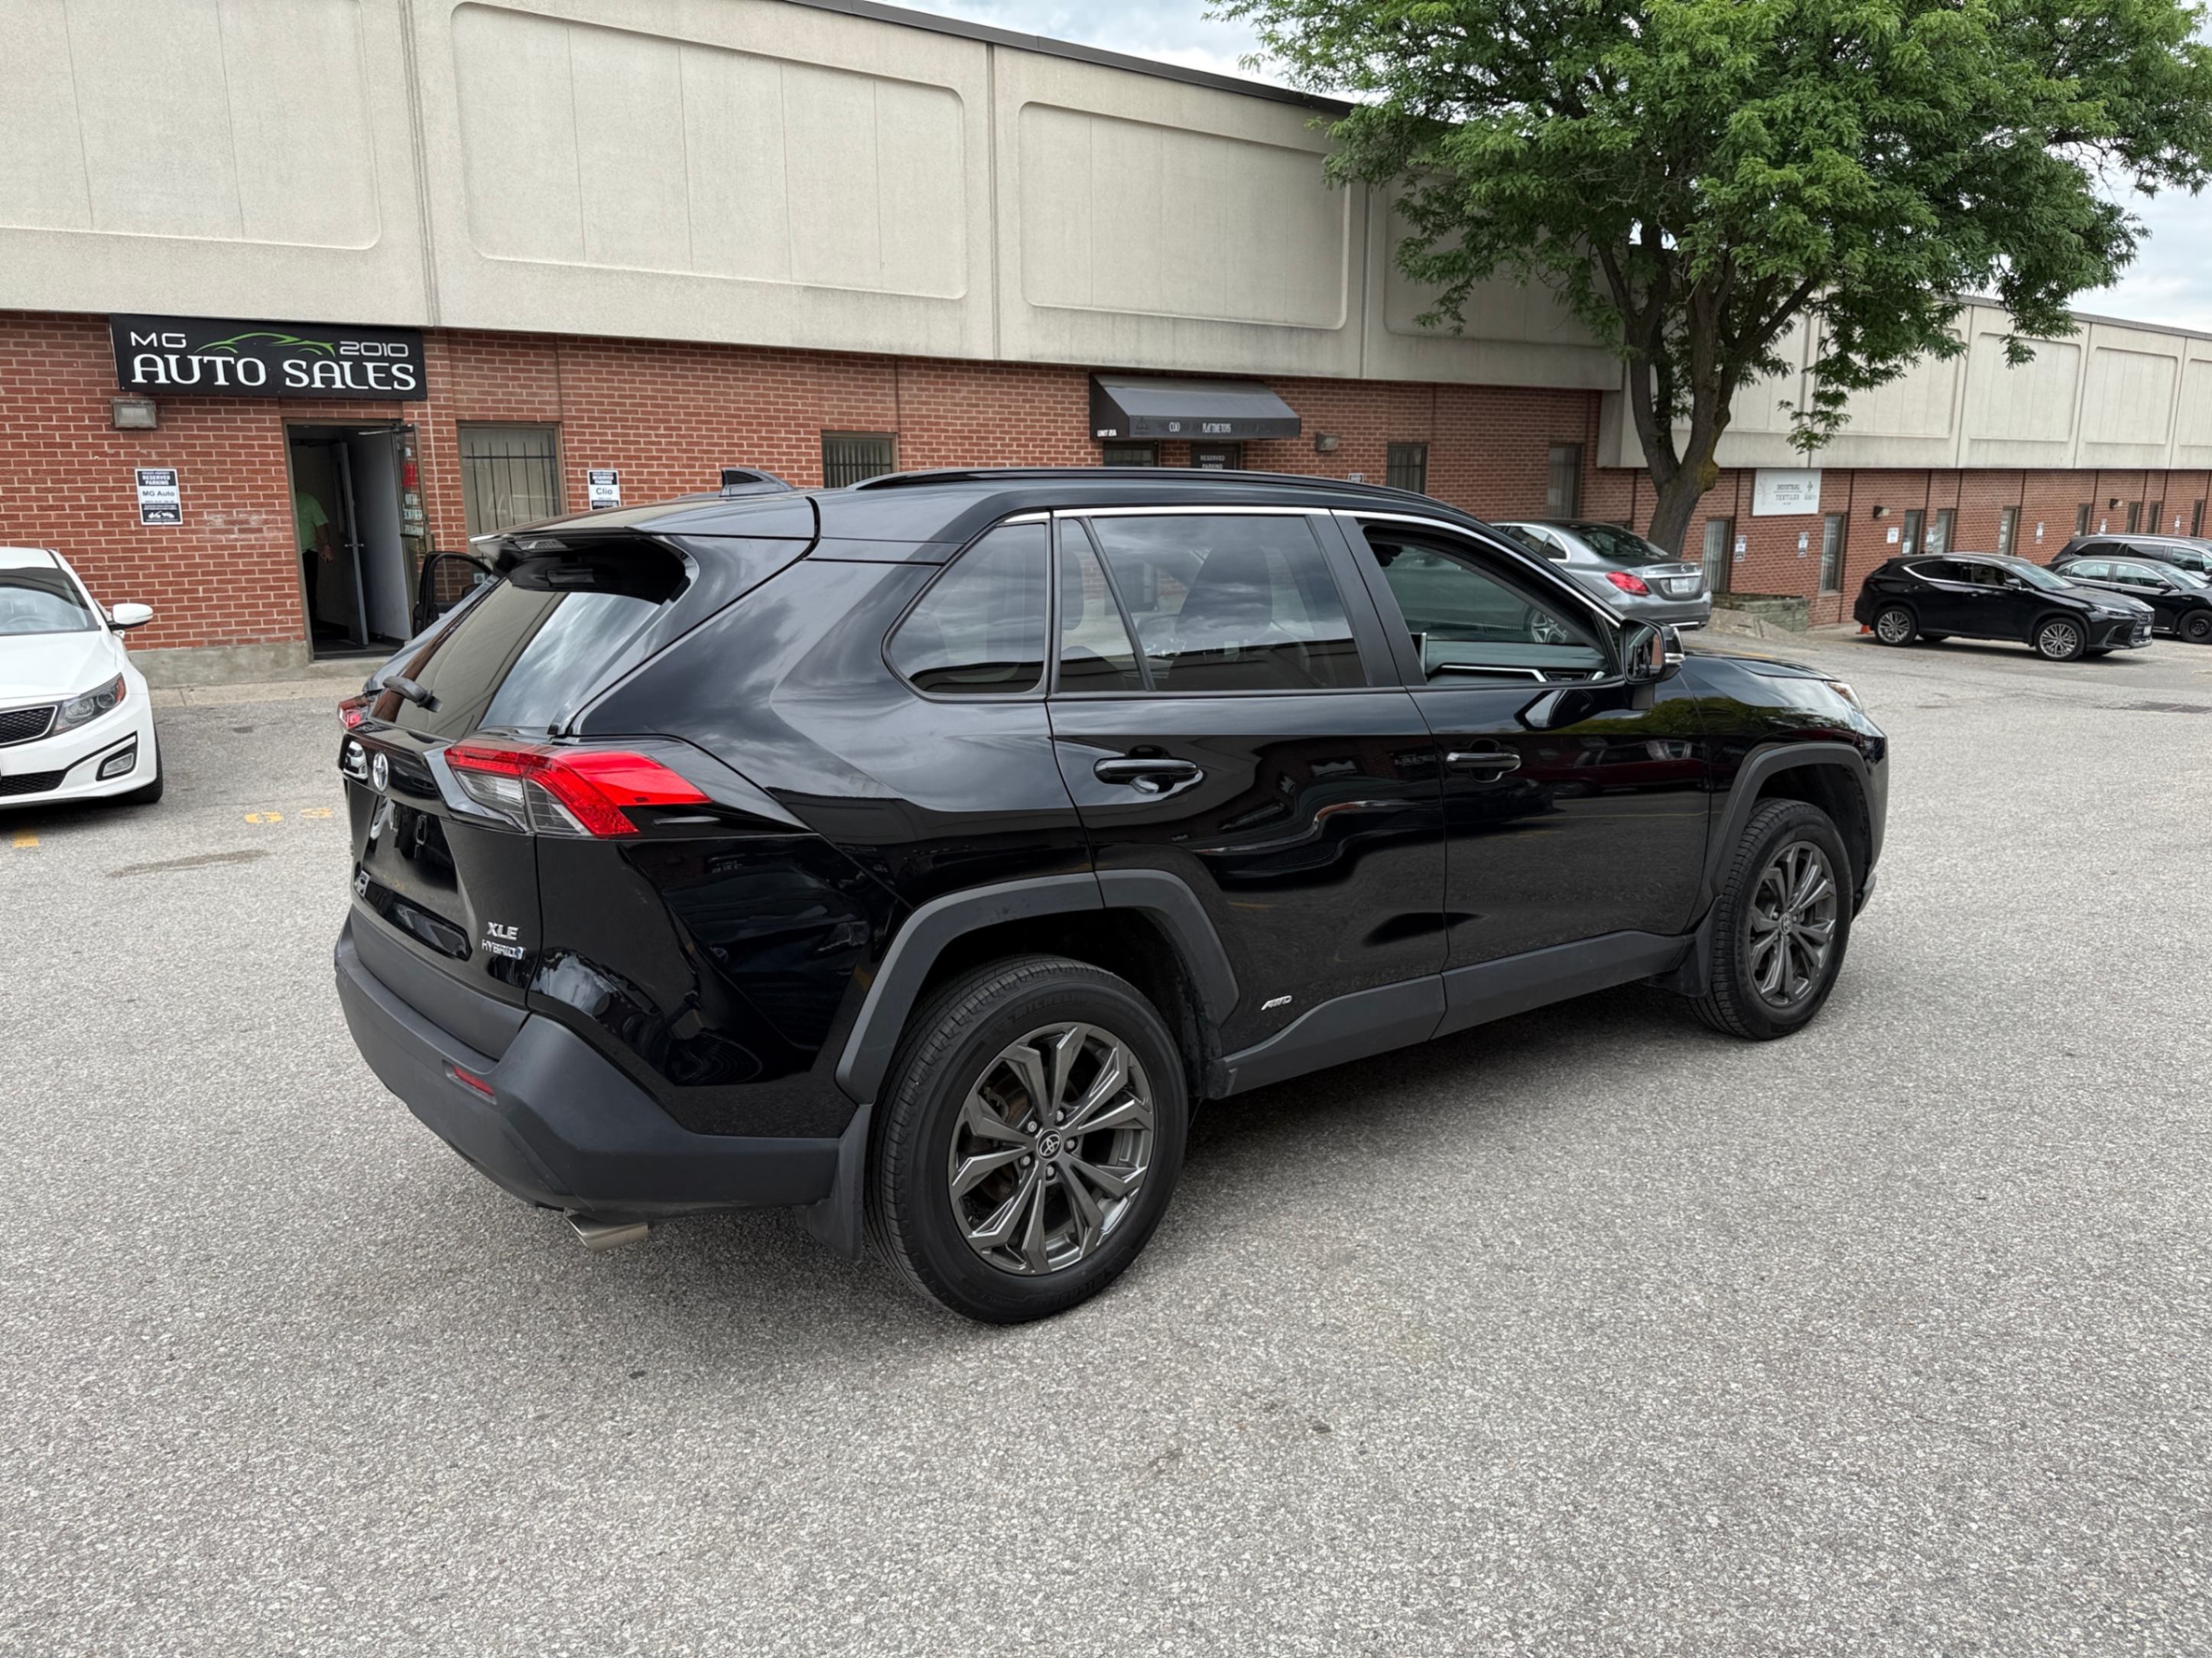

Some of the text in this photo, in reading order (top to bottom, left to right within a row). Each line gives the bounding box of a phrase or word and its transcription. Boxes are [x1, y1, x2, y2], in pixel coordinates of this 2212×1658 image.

[130, 330, 409, 358] MG 2010
[131, 353, 417, 391] AUTO SALES
[487, 922, 518, 941] XLE
[482, 939, 516, 958] HYBRID
[1261, 995, 1292, 1010] AWD
